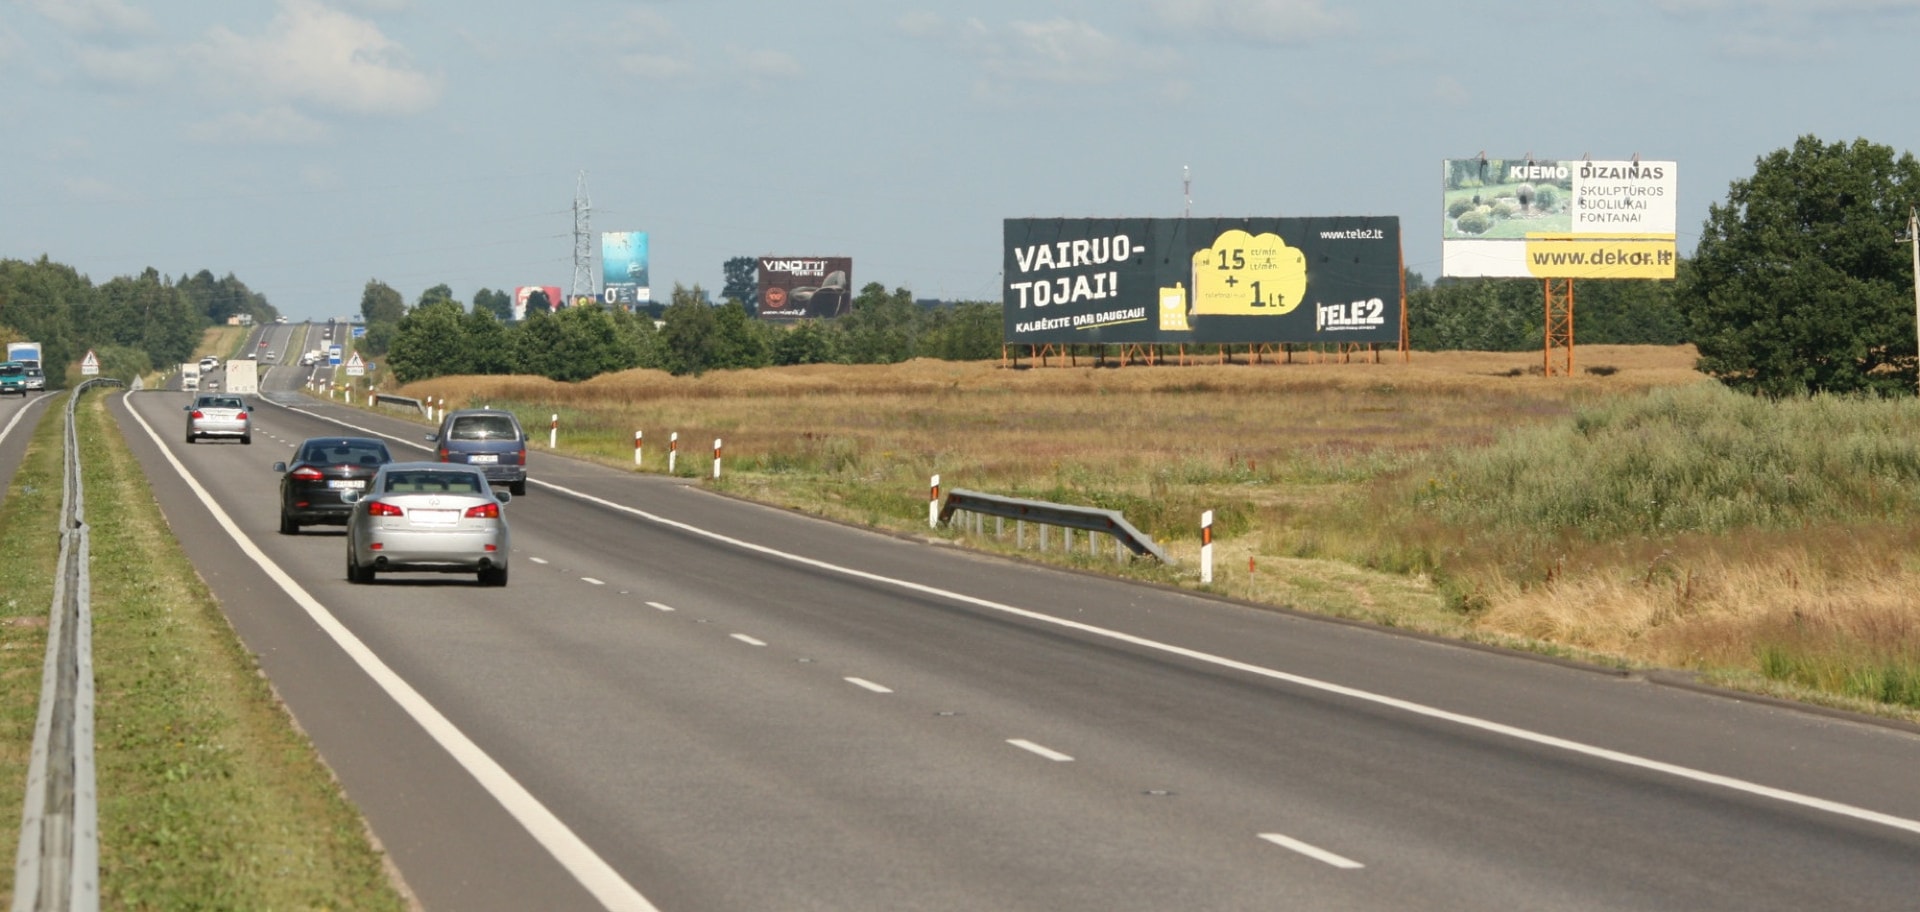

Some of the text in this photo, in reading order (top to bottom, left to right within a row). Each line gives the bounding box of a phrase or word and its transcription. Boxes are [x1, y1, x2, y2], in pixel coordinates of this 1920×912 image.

[1510, 166, 1664, 179] KIEMO DIZAINAS
[1580, 198, 1647, 210] SUOLIUKAI
[1580, 213, 1641, 222] FONTANAI
[1320, 229, 1384, 240] www.tele2.lt
[1015, 234, 1145, 272] VAIRUO-
[1217, 248, 1245, 270] 15
[1533, 249, 1672, 265] www.dekor.lt
[1010, 271, 1118, 308] TOJAI!
[1073, 313, 1095, 326] DAR
[1096, 307, 1145, 323] DAUGIAU!
[1318, 298, 1384, 326] TELE2
